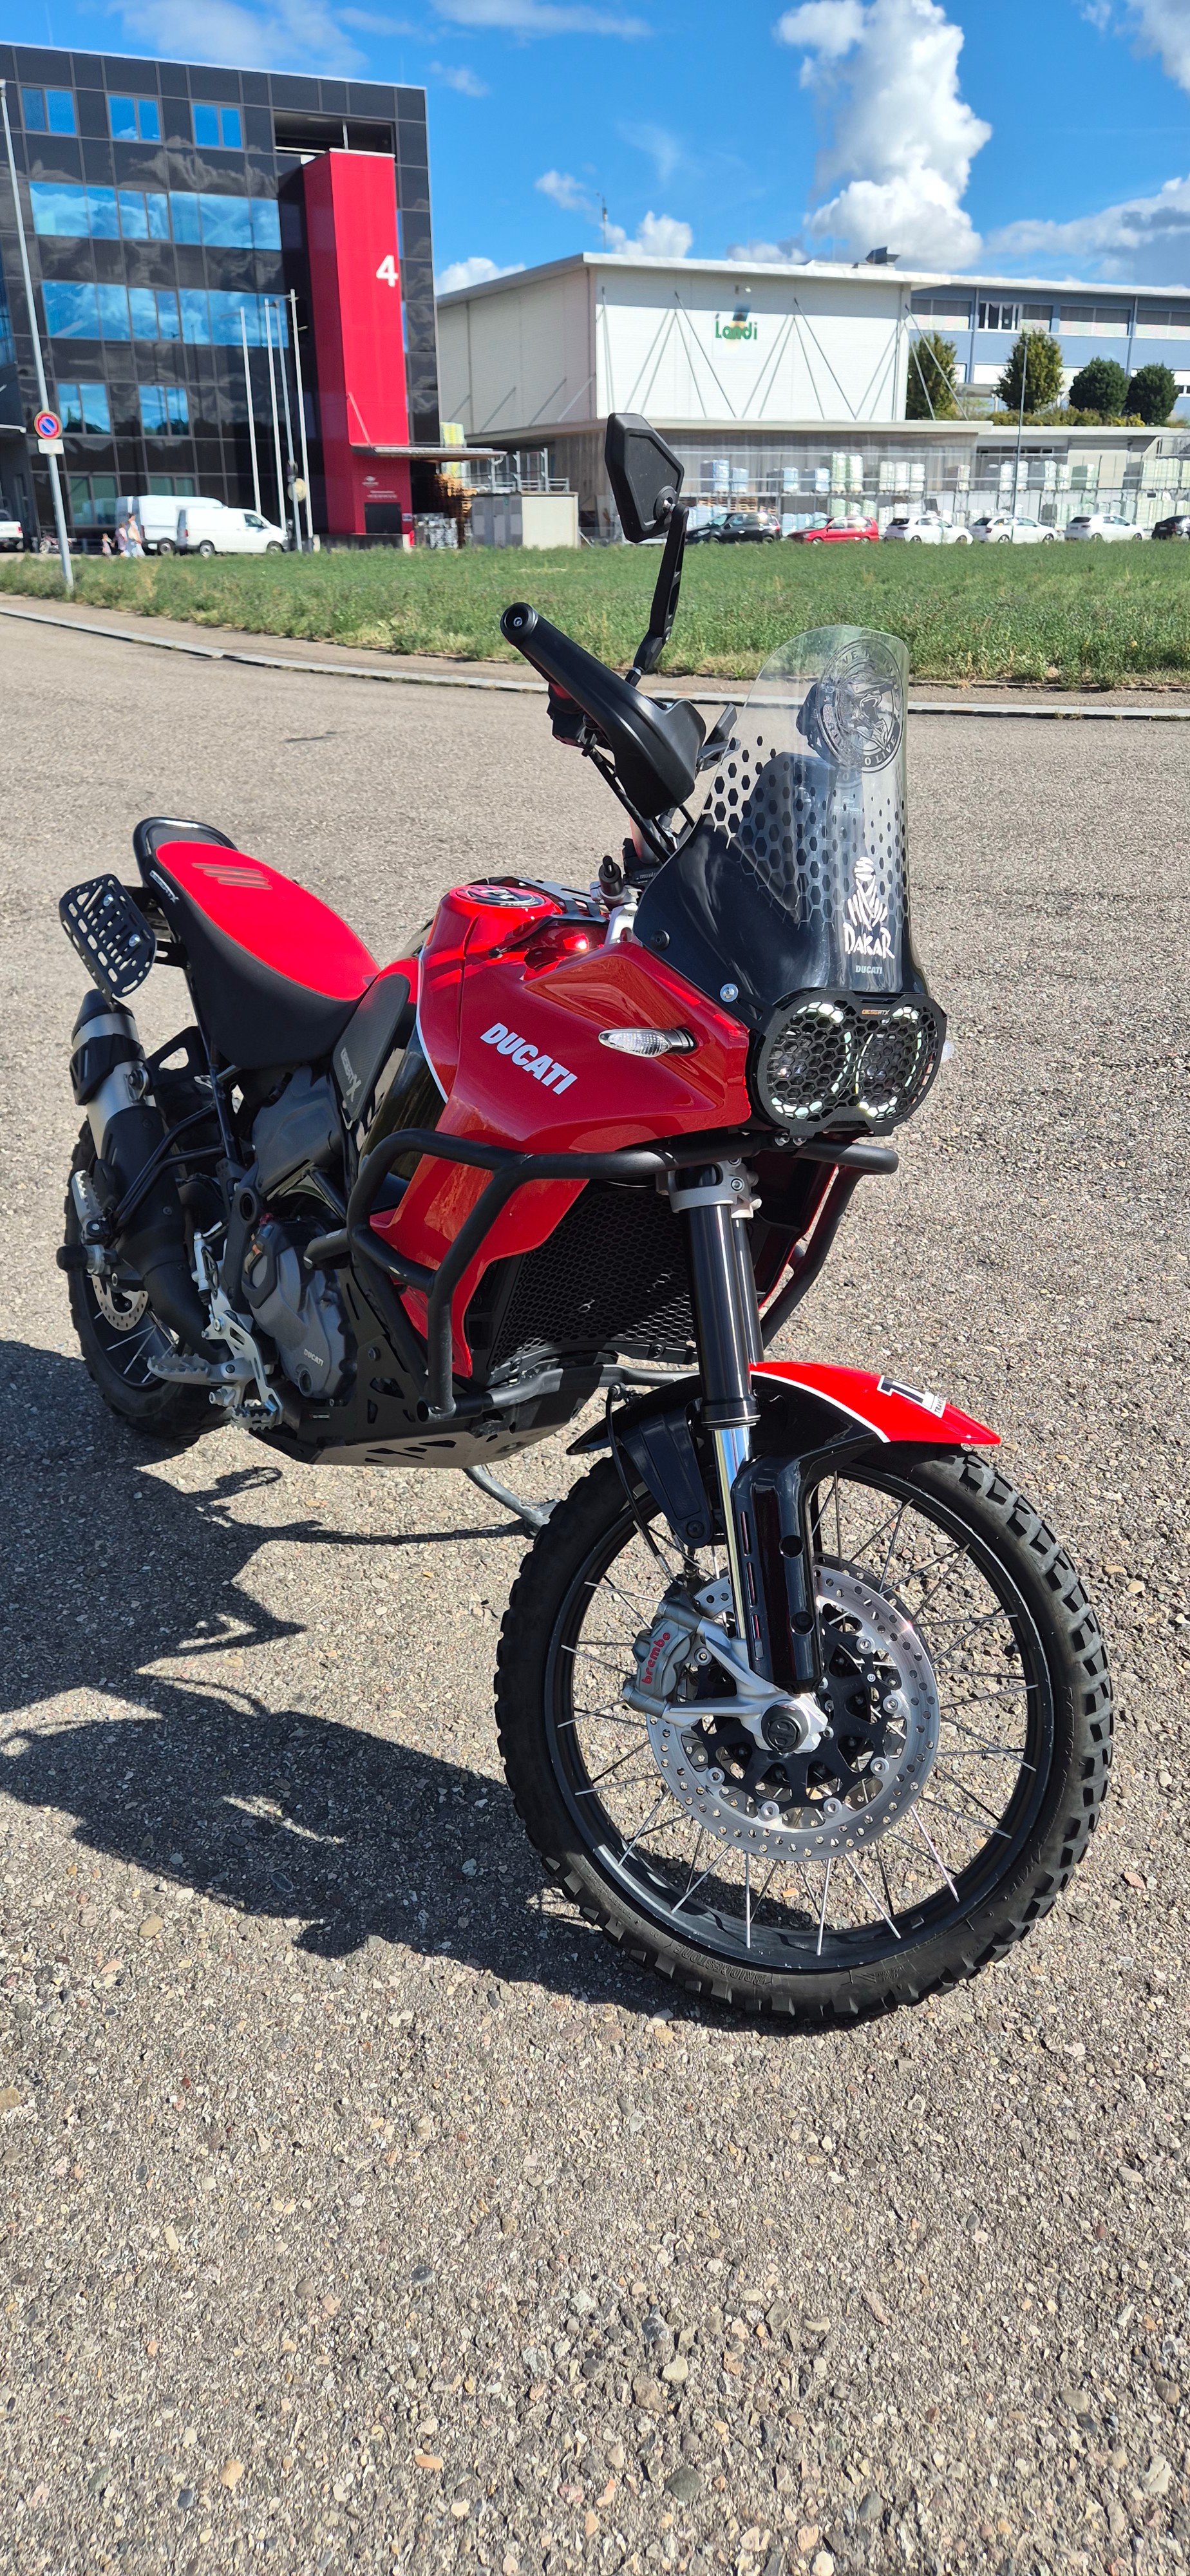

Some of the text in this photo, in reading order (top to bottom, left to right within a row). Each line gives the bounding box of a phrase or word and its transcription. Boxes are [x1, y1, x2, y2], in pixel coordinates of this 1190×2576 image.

[375, 254, 399, 288] 4
[875, 737, 898, 764] LIVE
[843, 922, 895, 959] DAKAR
[855, 965, 883, 975] DUCATI
[479, 1018, 578, 1095] DUCATI
[303, 1349, 324, 1367] DUCATI
[641, 1632, 671, 1685] brembo
[674, 1943, 767, 1986] BRIDGESTONE
